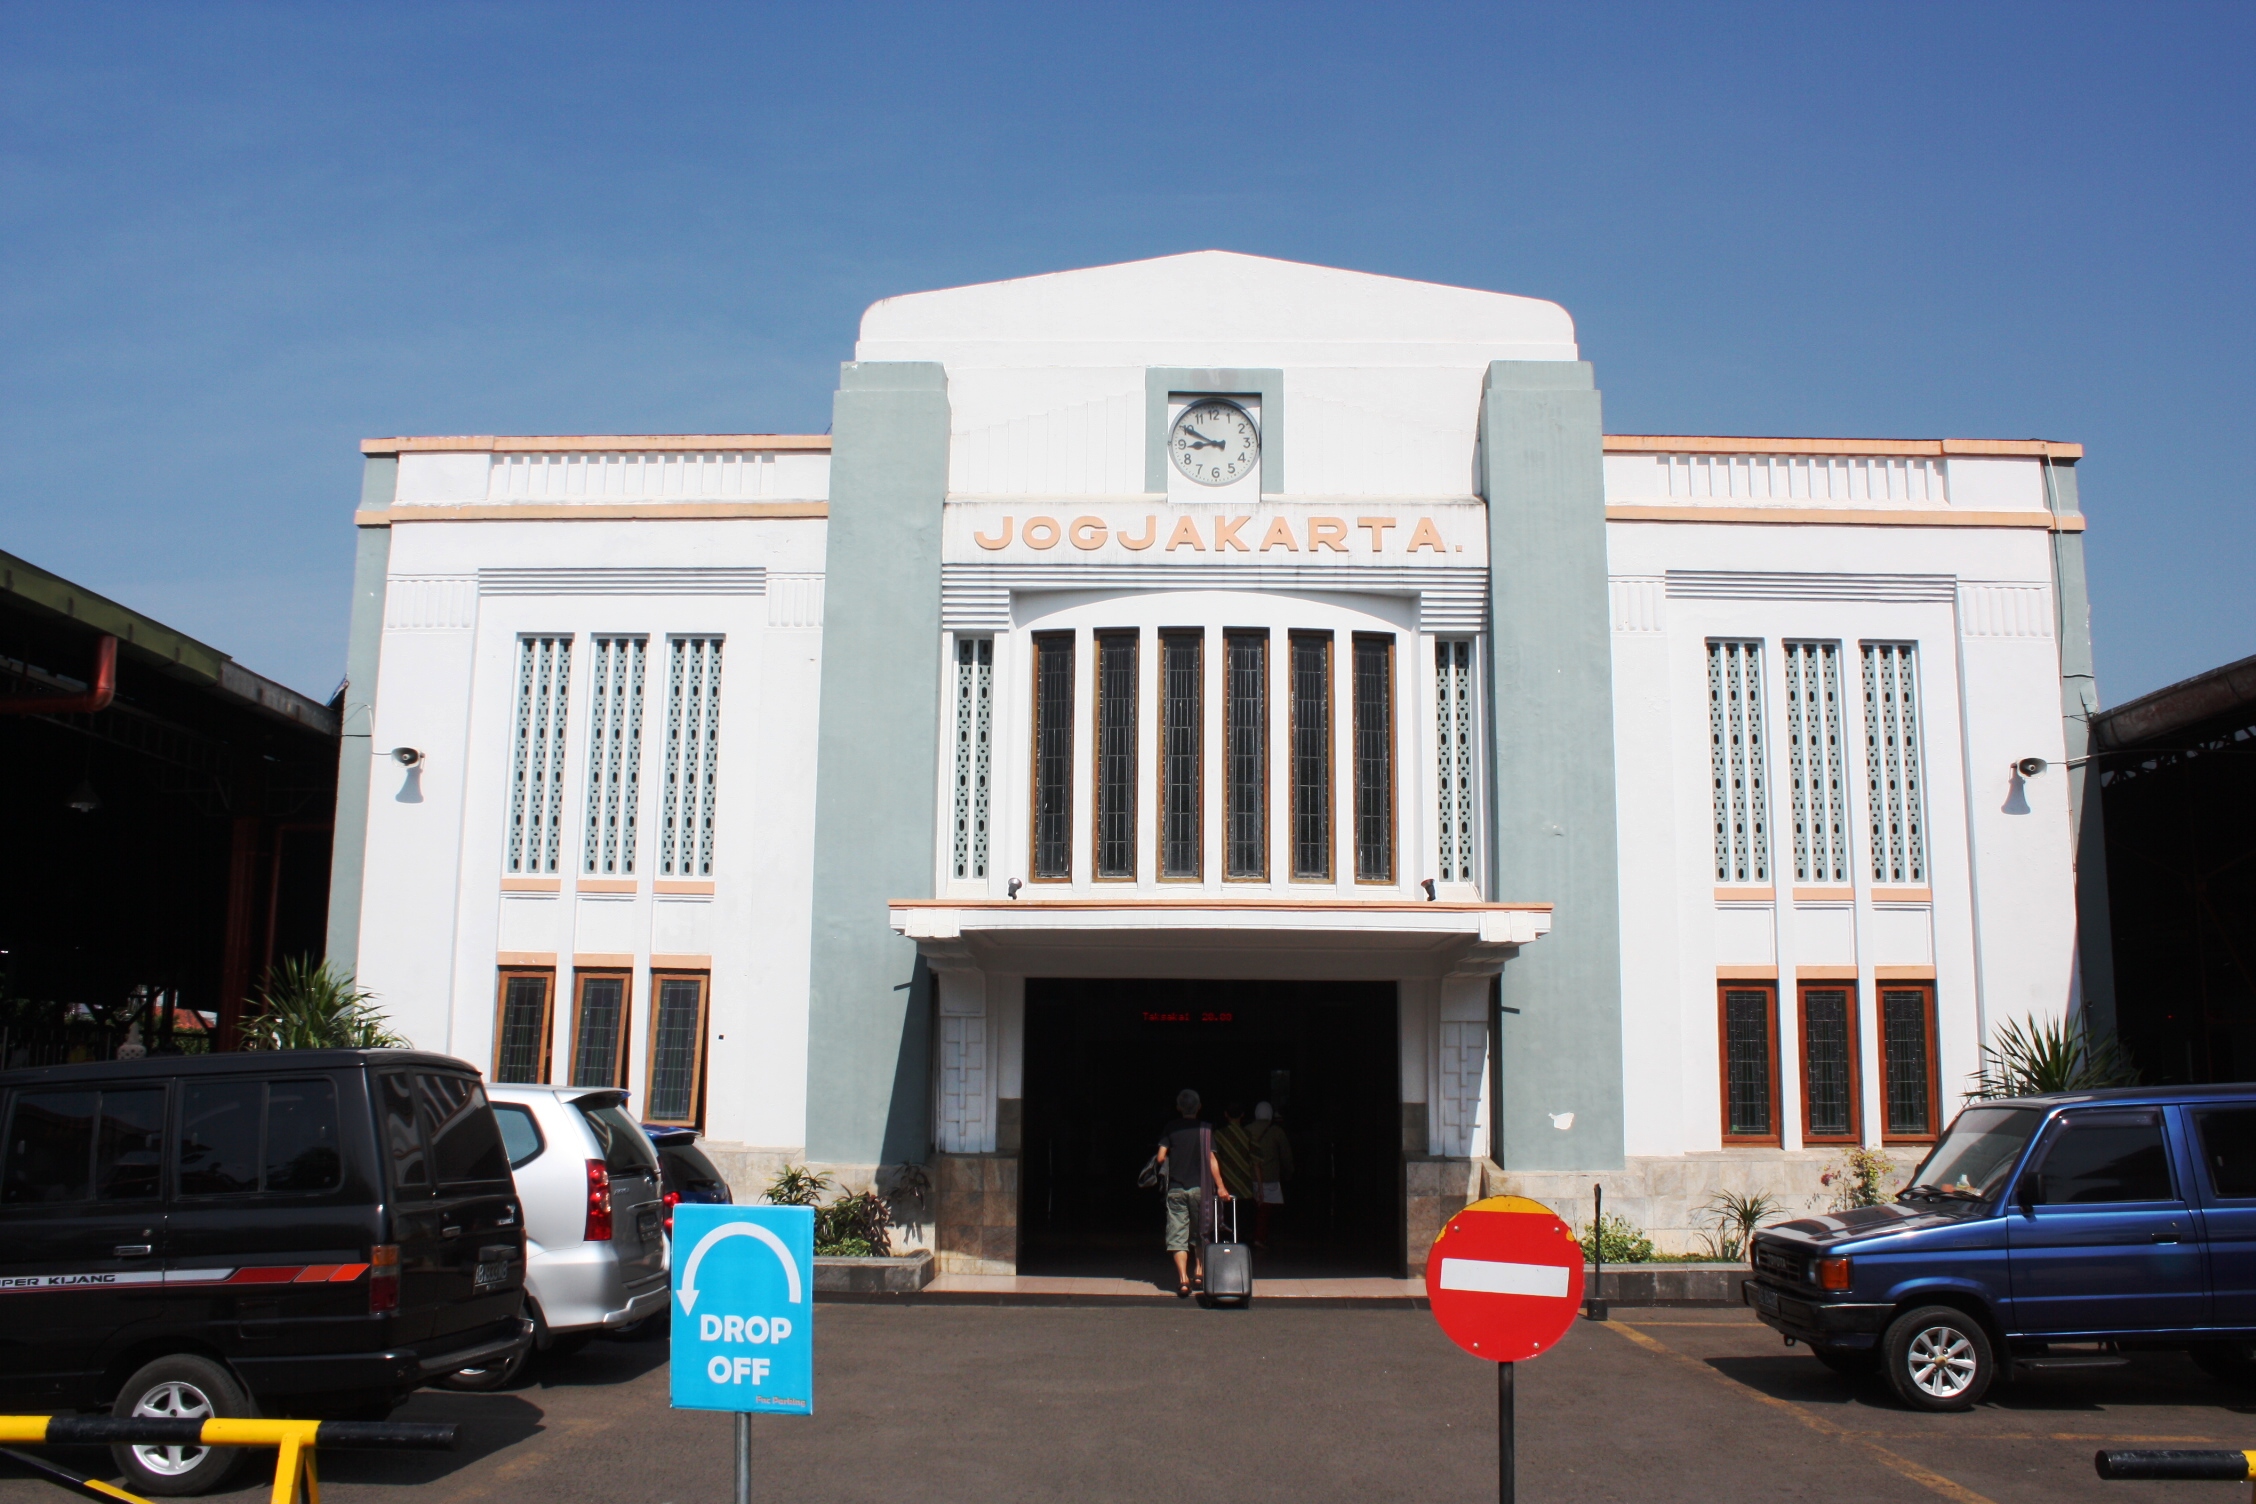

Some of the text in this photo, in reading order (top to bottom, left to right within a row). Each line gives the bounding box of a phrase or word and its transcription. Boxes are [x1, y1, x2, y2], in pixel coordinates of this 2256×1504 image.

[1195, 414, 1203, 424] 11
[1208, 410, 1220, 421] 12
[1226, 413, 1231, 424] 1
[1238, 423, 1245, 434] 2
[1178, 439, 1187, 450] 9
[1243, 437, 1251, 449] 3
[1184, 453, 1192, 465] 8
[1237, 452, 1246, 463] 4
[1196, 464, 1203, 475] 7
[1211, 467, 1220, 478] 6
[1227, 463, 1236, 474] 5
[973, 514, 1463, 553] JOGJAKARTA.
[48, 1274, 116, 1285] KIJANG
[700, 1313, 792, 1345] DROP
[707, 1355, 771, 1386] OFF
[773, 1396, 807, 1408] Parking
